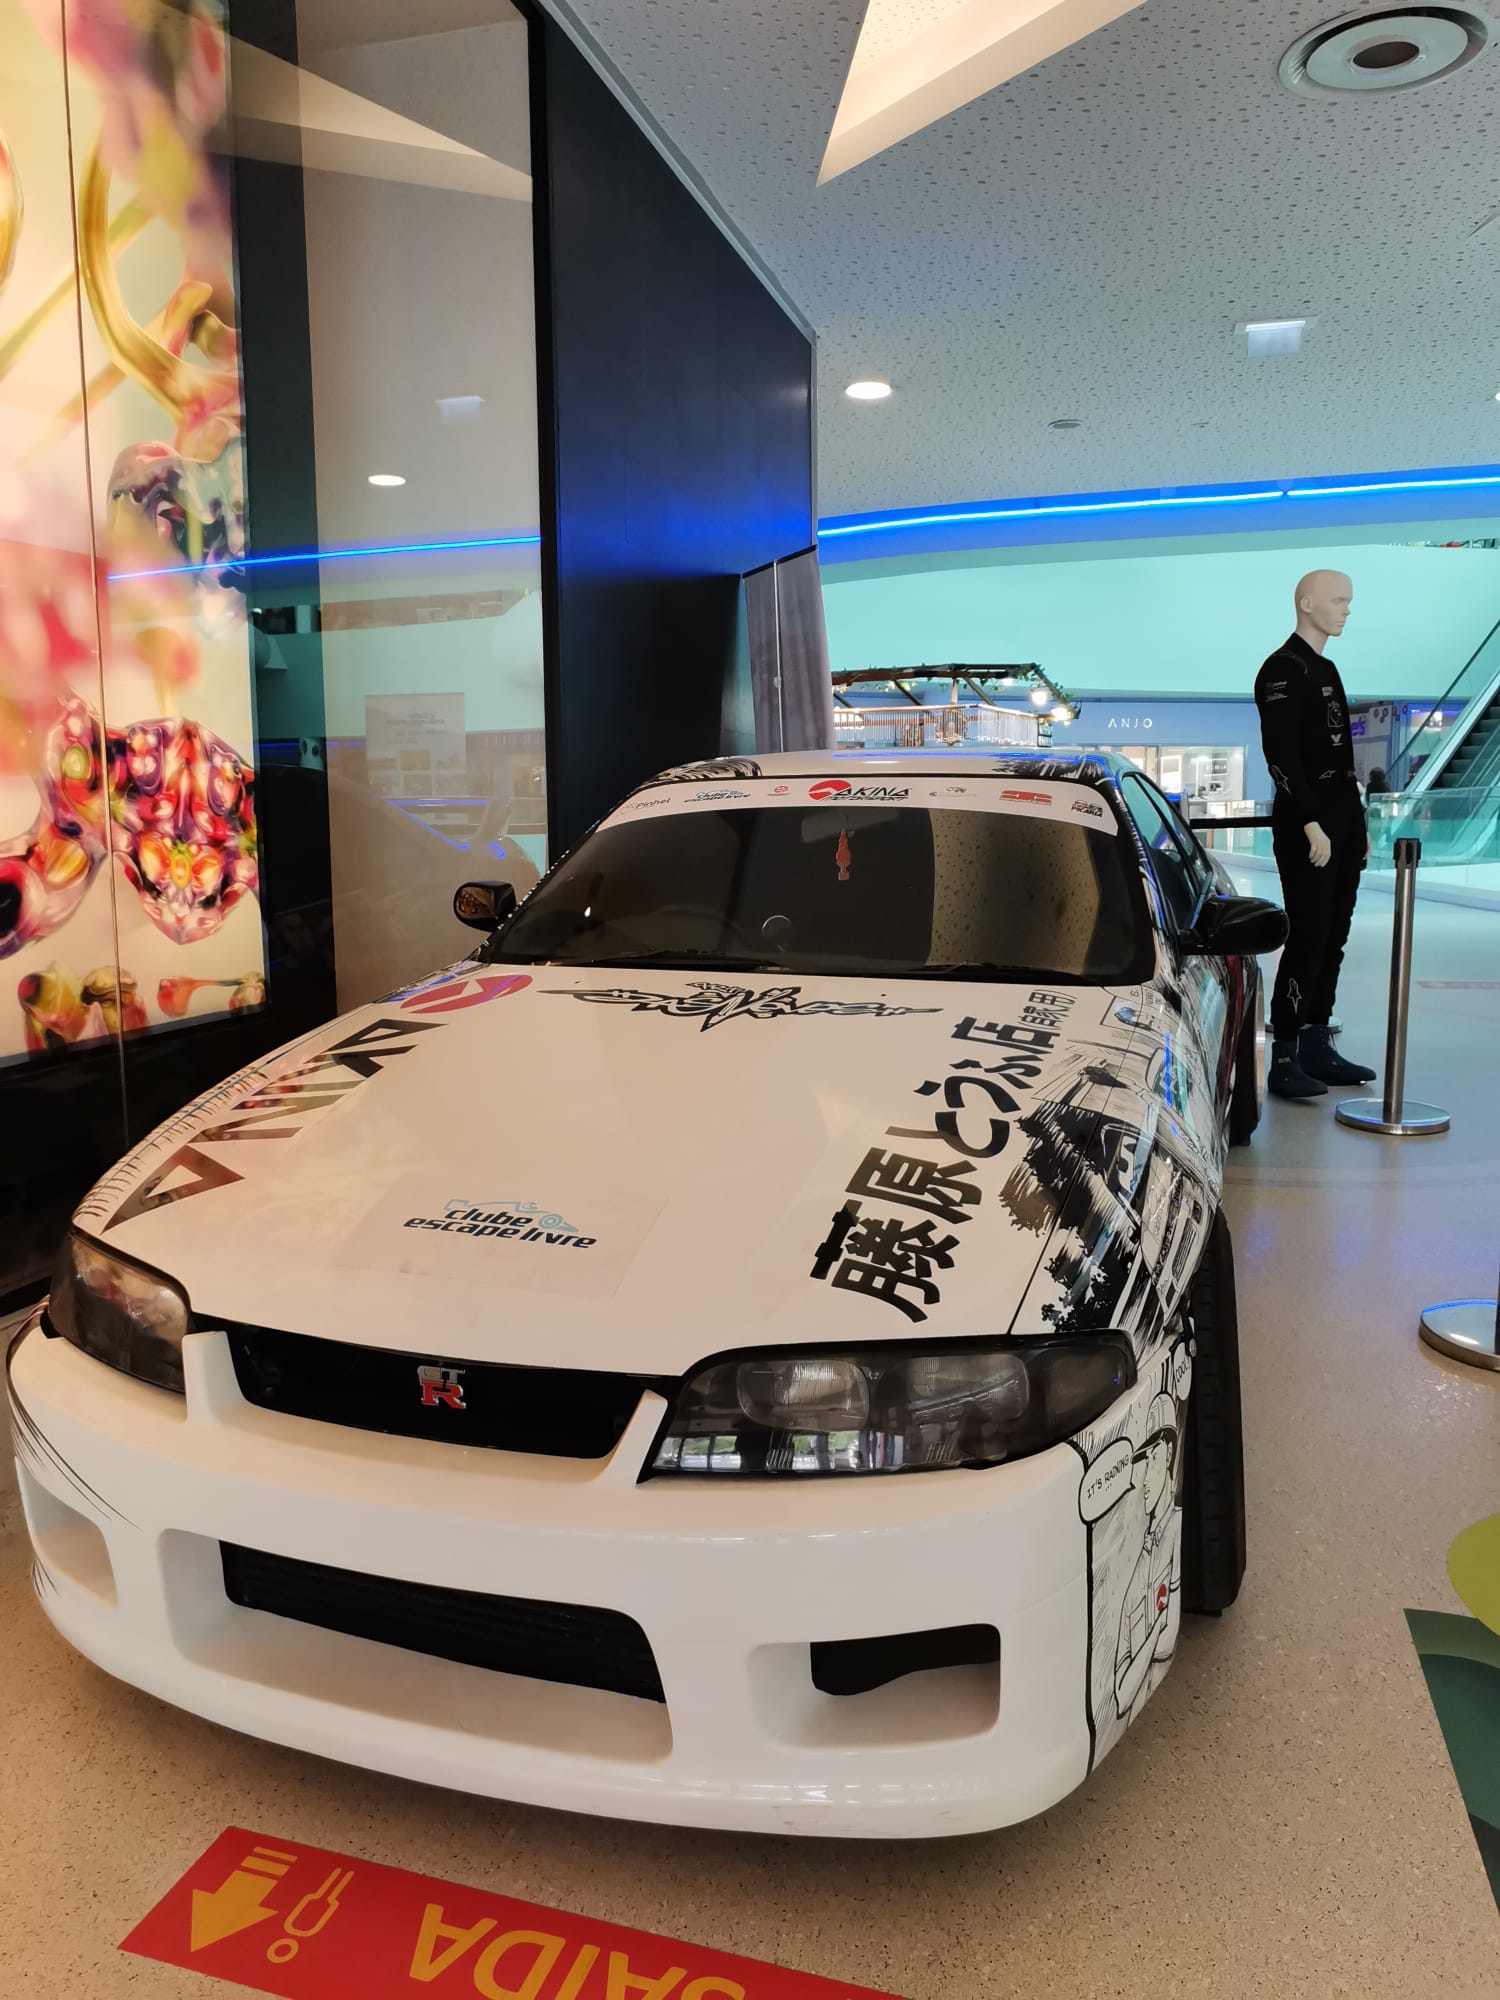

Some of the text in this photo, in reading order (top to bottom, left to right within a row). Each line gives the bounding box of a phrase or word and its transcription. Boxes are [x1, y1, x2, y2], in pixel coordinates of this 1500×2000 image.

[1108, 718, 1153, 728] ANJO
[832, 786, 910, 796] AKINA
[99, 1018, 449, 1235] AKINA
[444, 1208, 534, 1227] clube
[403, 1217, 598, 1249] escape livre
[1087, 1454, 1130, 1500] IT'S RAINING
